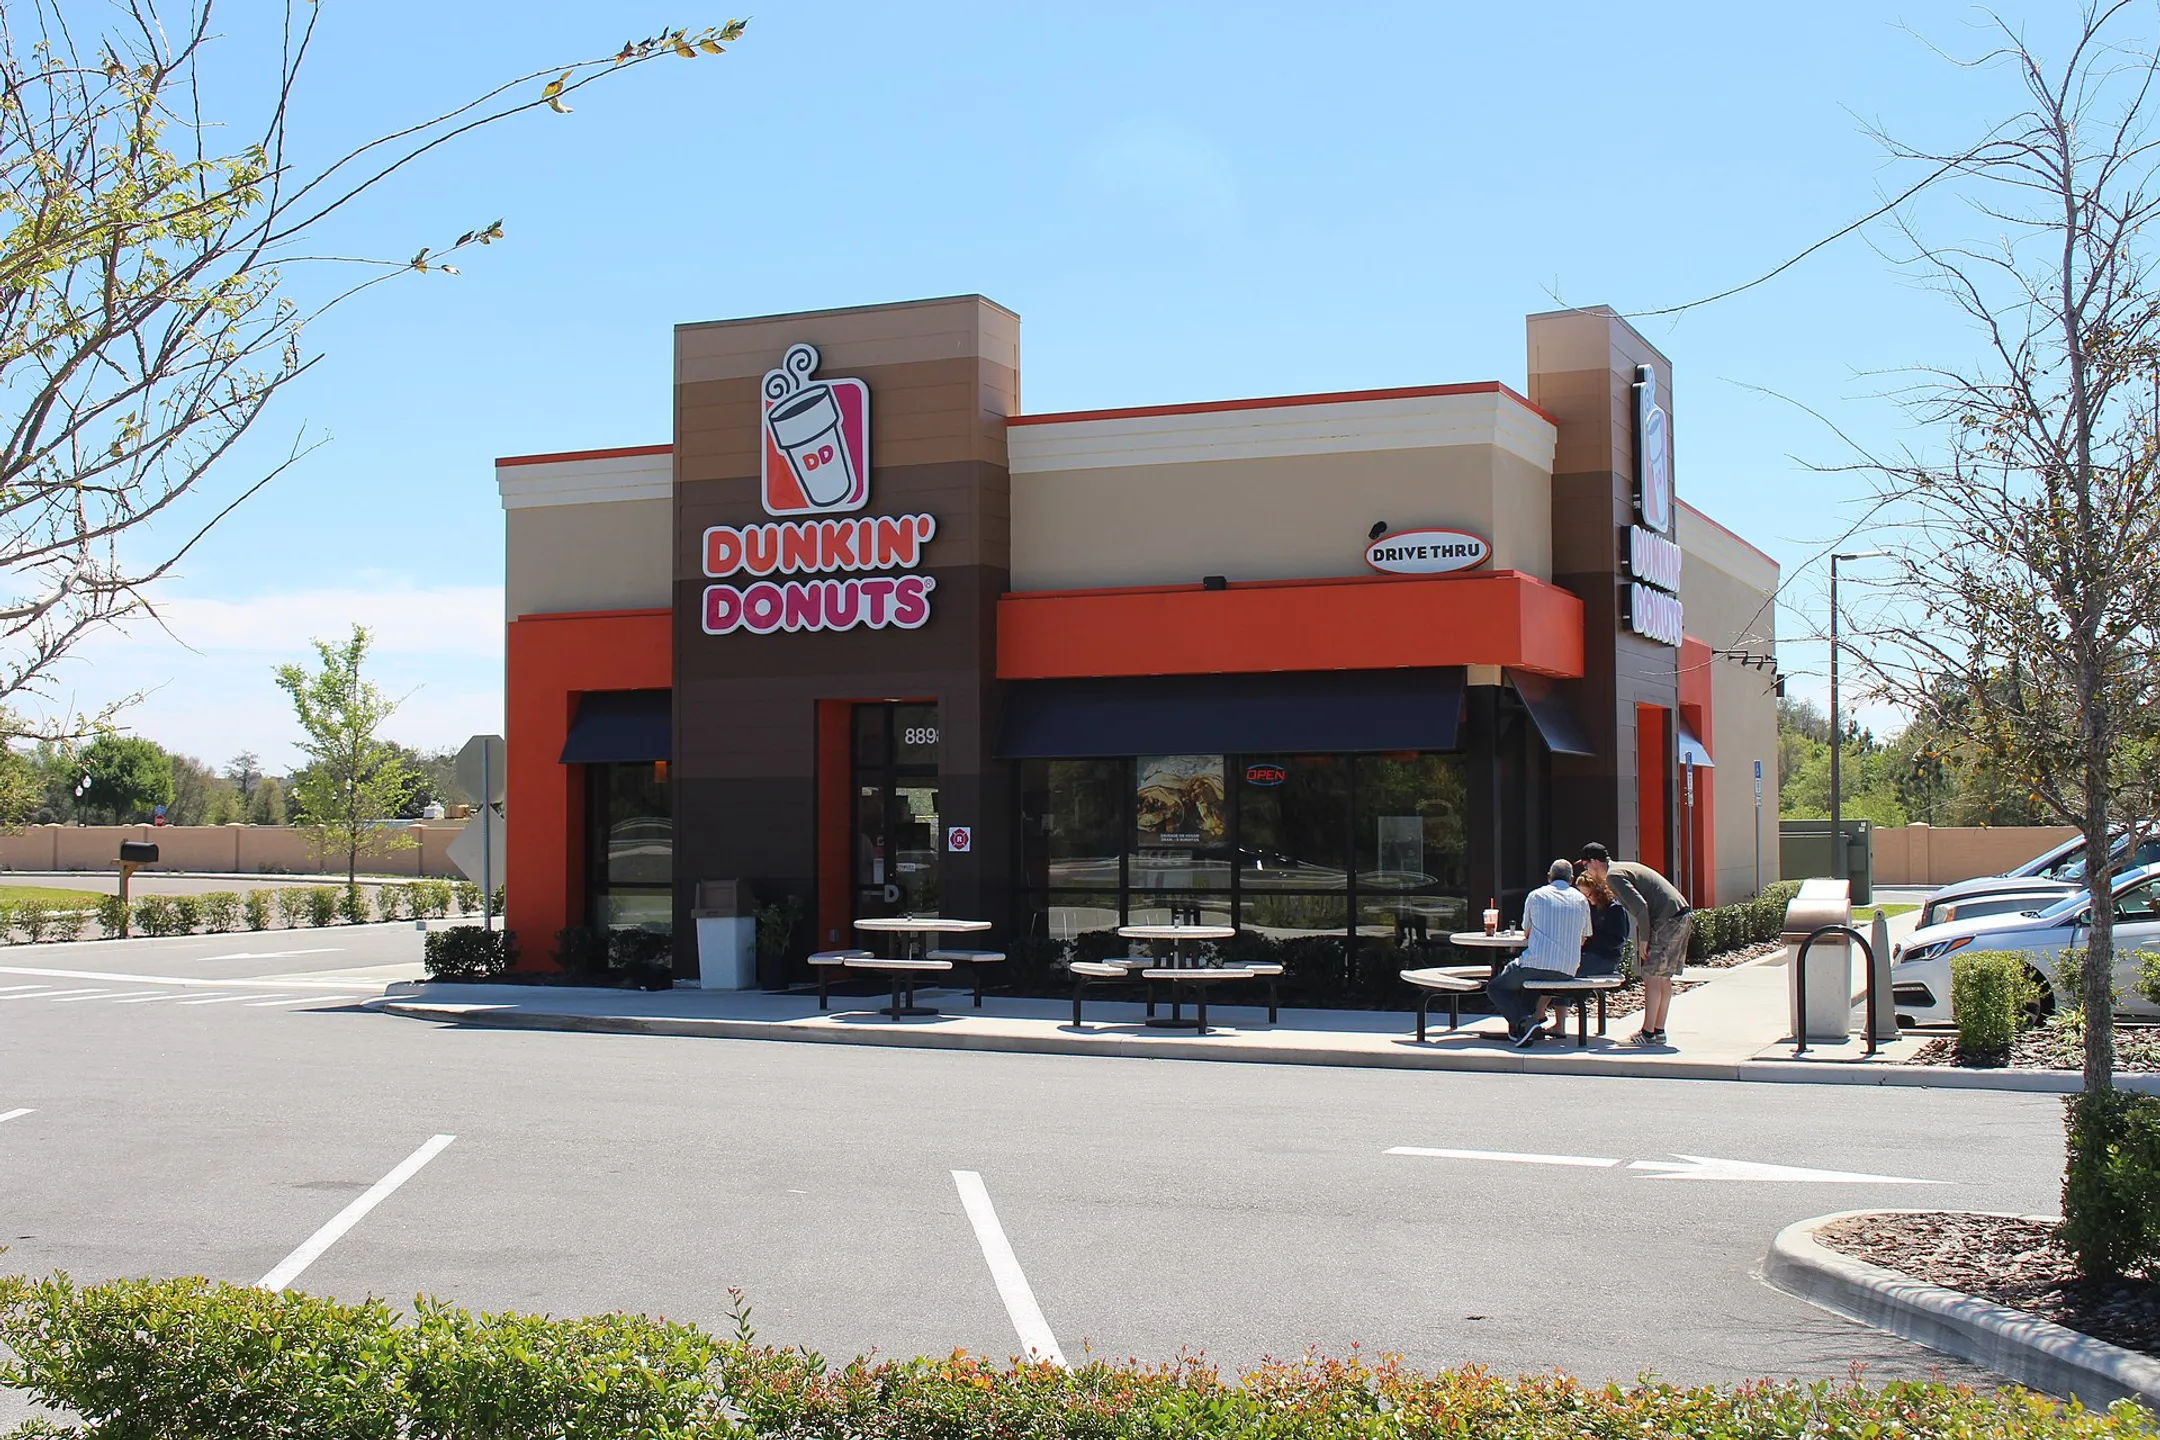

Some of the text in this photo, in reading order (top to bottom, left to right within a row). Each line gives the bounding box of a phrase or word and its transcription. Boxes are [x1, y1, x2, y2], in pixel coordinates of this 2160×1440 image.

[802, 444, 834, 472] DD
[705, 514, 931, 575] DUNKIN'
[1373, 543, 1480, 562] DRIVE THRU
[705, 577, 928, 631] DONUTS
[905, 727, 939, 744] 889
[1246, 769, 1285, 781] OPEN
